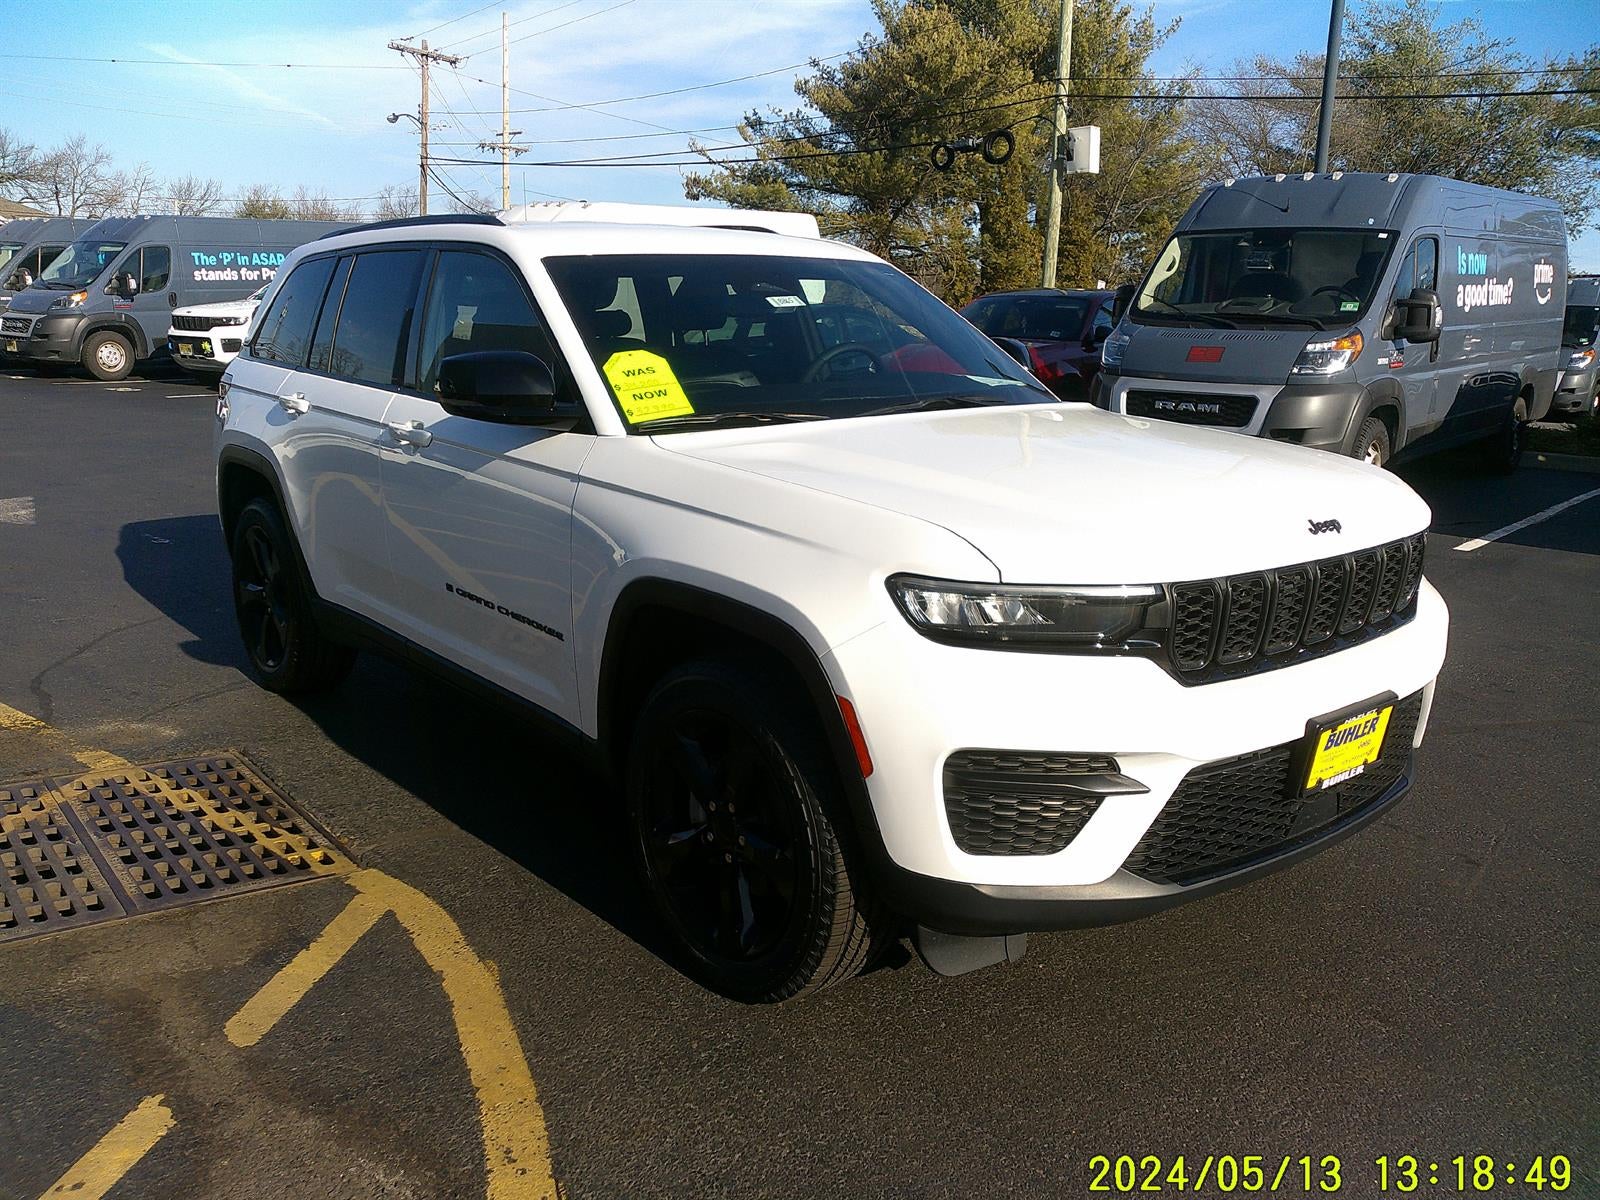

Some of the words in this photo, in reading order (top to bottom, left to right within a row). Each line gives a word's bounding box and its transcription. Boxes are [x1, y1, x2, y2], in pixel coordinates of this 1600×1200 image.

[191, 252, 217, 266] The
[237, 252, 249, 266] in
[252, 252, 285, 266] ASAP
[1457, 246, 1466, 275] Is
[1468, 252, 1487, 275] now
[193, 267, 239, 281] stands
[240, 267, 260, 281] for
[1533, 259, 1553, 288] prime
[1457, 284, 1463, 307] a
[1464, 278, 1488, 312] good
[1489, 277, 1514, 306] time?
[622, 366, 656, 378] WAS
[632, 388, 668, 401] NOW
[1154, 400, 1219, 414] RAM
[1307, 518, 1342, 535] Jeep
[455, 587, 495, 610] GRAND
[497, 605, 565, 641] CHEROKEE
[1323, 716, 1380, 752] BUHLER
[1321, 764, 1365, 790] BUHLER
